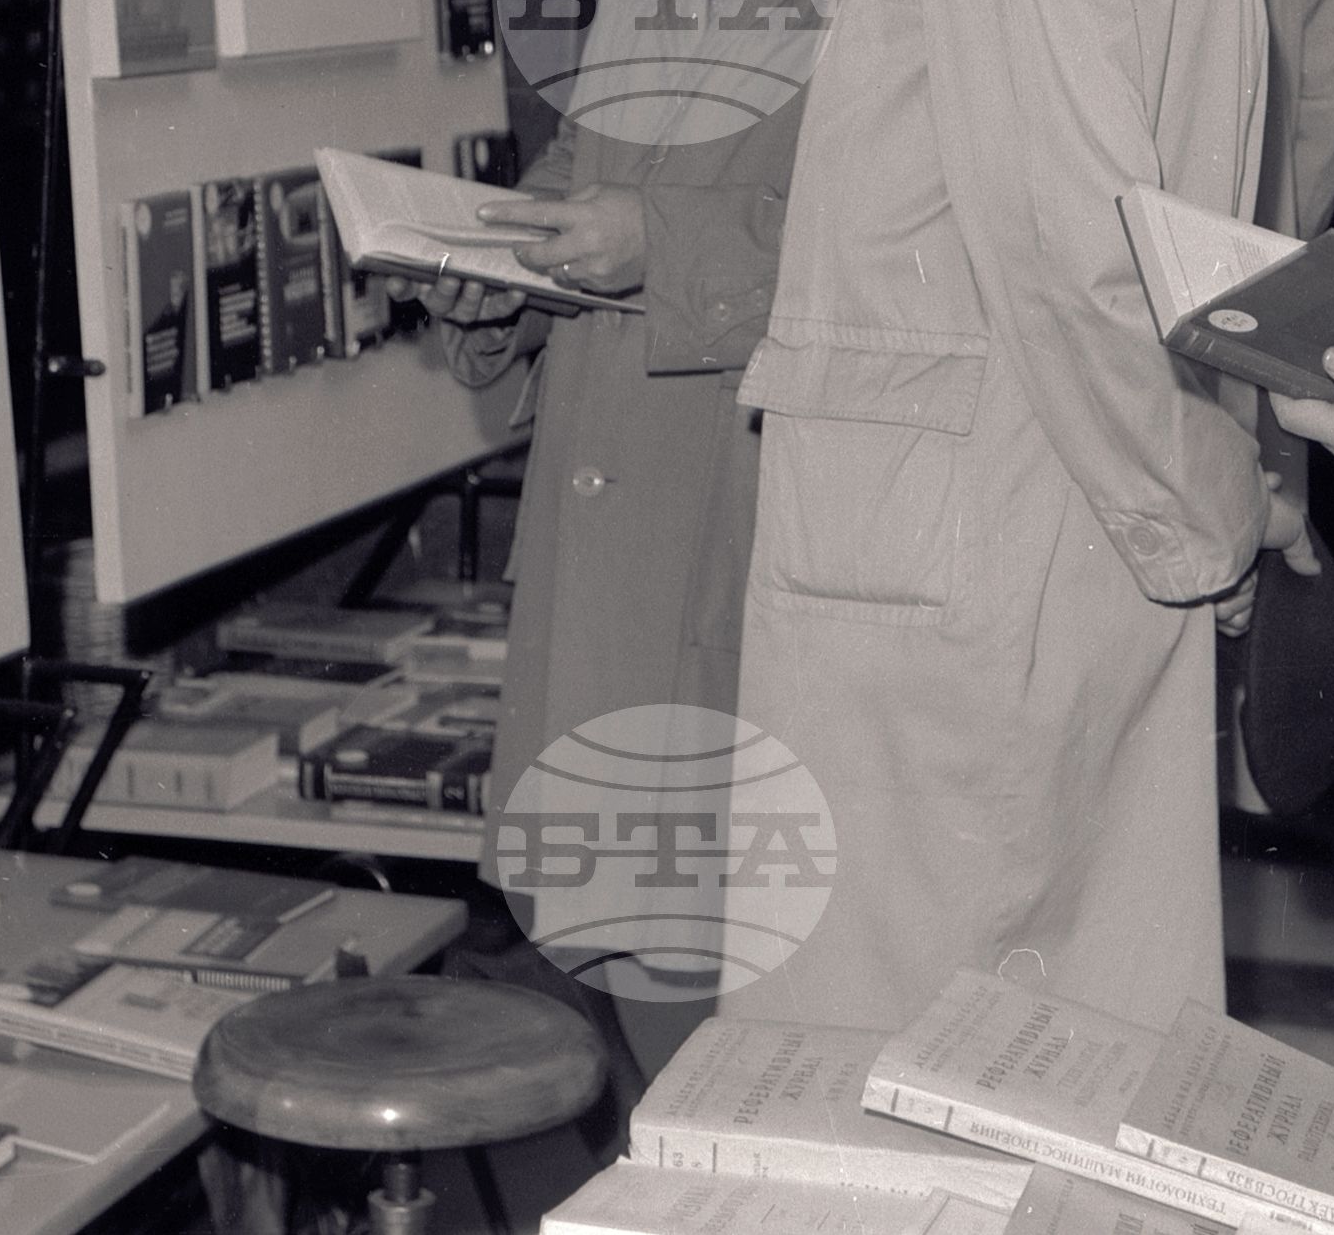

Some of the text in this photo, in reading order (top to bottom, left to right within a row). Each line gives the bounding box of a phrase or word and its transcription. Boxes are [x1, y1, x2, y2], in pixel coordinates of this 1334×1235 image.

[733, 1031, 806, 1125] РЕФЕРАТИВНЫЙ
[975, 1001, 1060, 1091] РЕФЕРАТИВНЫЙ
[1024, 1035, 1070, 1080] ЖУРНАЛ
[1226, 1052, 1287, 1157] РЕФЕРАТИВНЫЙ
[1267, 1094, 1304, 1146] ЖУРНАЛ
[966, 1119, 1230, 1216] ТЕХНОЛОГИЯ МАШИНОСТРОЕНИЯ
